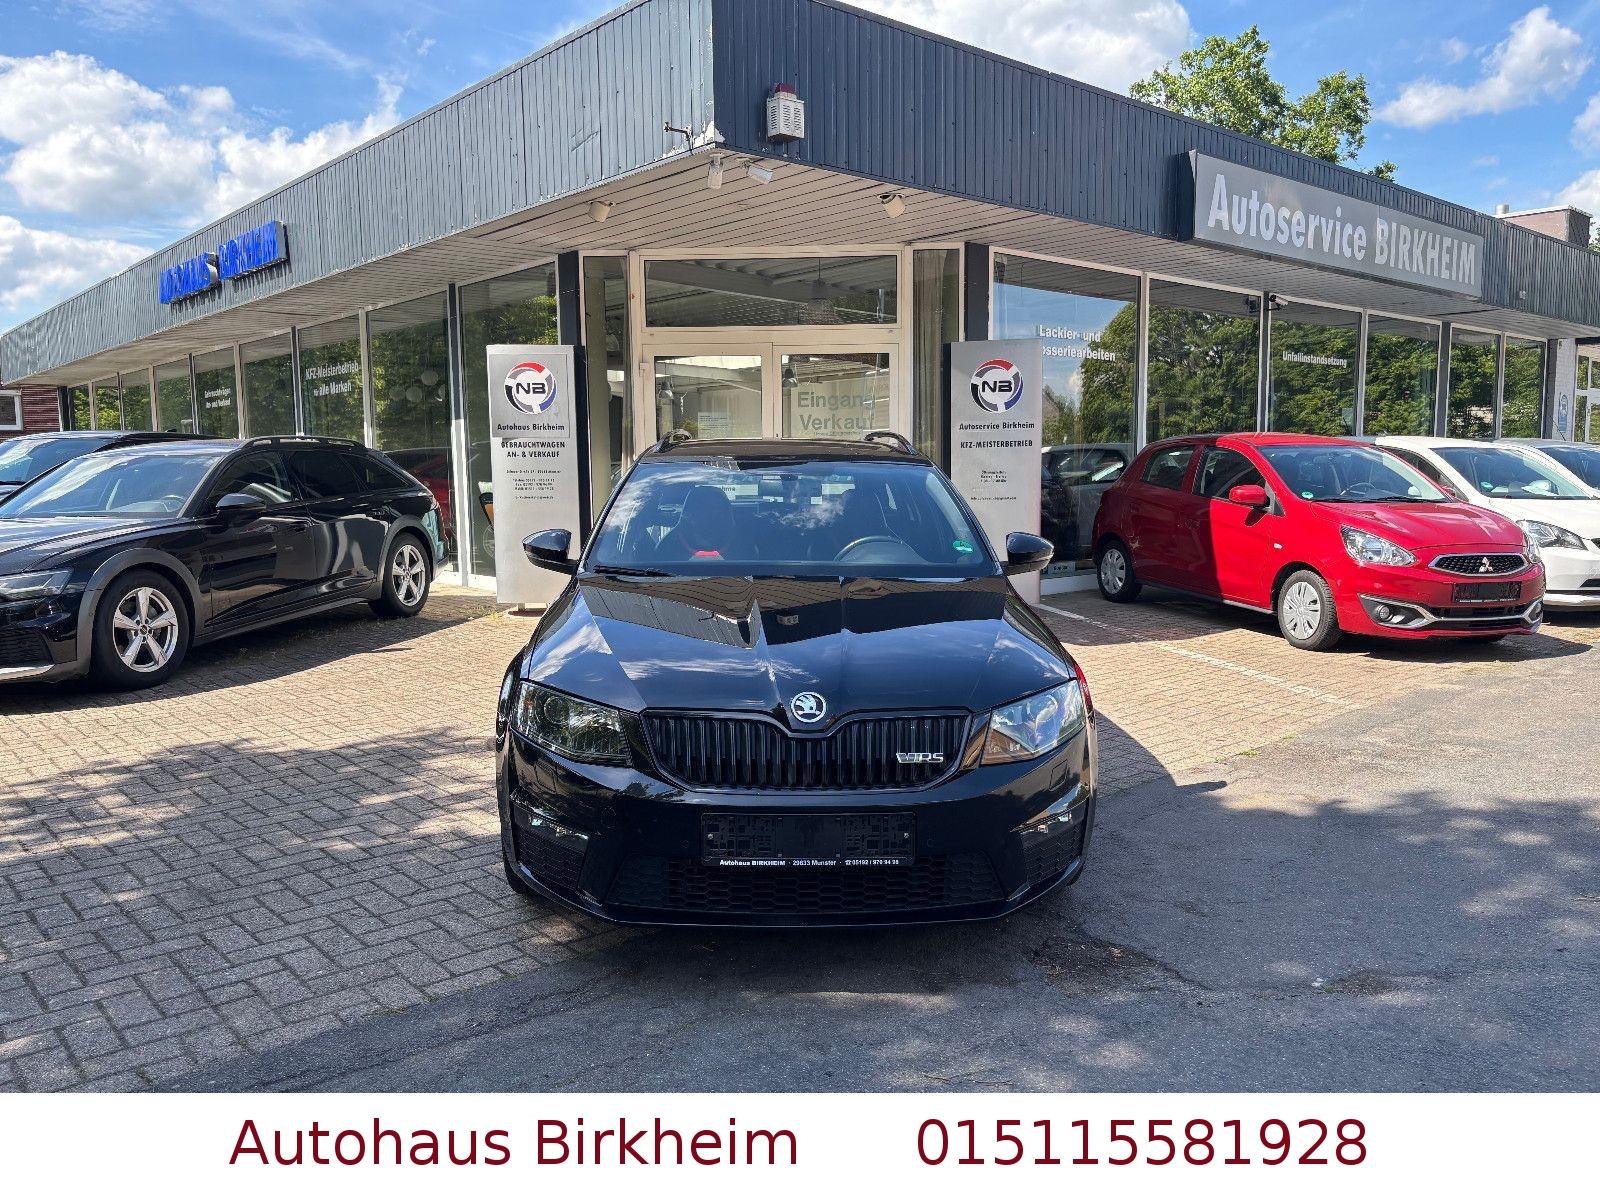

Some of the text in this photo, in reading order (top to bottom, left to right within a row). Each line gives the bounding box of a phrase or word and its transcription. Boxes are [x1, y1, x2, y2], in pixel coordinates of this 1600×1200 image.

[1207, 174, 1476, 286] Autoservice BIRKHEIM
[1039, 324, 1101, 343] Lackier- und
[1282, 350, 1348, 369] Unfallinstandsetzung
[305, 359, 359, 381] KFZ-Meisterbetrieb
[330, 380, 352, 395] Marken
[515, 382, 547, 395] NB
[981, 380, 1013, 393] NB
[797, 391, 876, 411] Eingang
[497, 423, 565, 431] Autohaus Birkheim
[798, 414, 875, 431] Verkauf
[959, 422, 1035, 431] Autoservice Birkheim
[501, 441, 566, 449] GEBRAUCHTWAGEN
[960, 440, 1033, 449] KFZ-MEISTERBETRIEB
